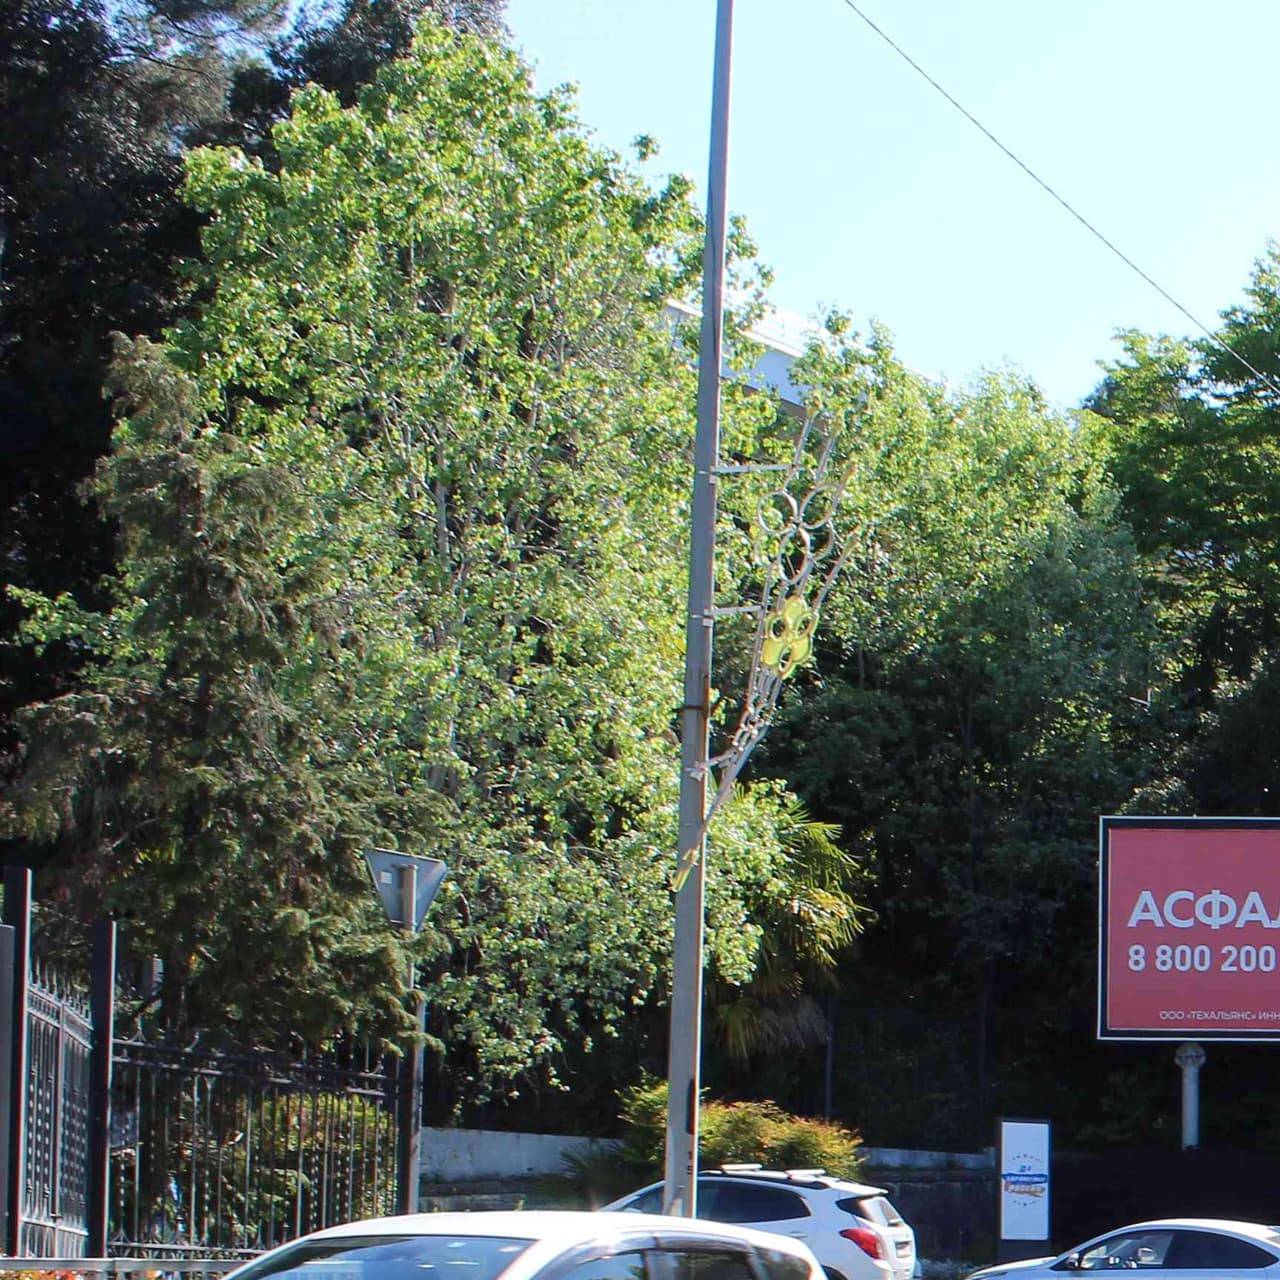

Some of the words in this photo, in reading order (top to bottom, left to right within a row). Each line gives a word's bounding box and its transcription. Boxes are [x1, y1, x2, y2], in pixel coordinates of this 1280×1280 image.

[1128, 945, 1146, 971] 8
[1155, 945, 1211, 971] 800
[1220, 946, 1276, 972] 200
[1159, 1011, 1185, 1021] ООО
